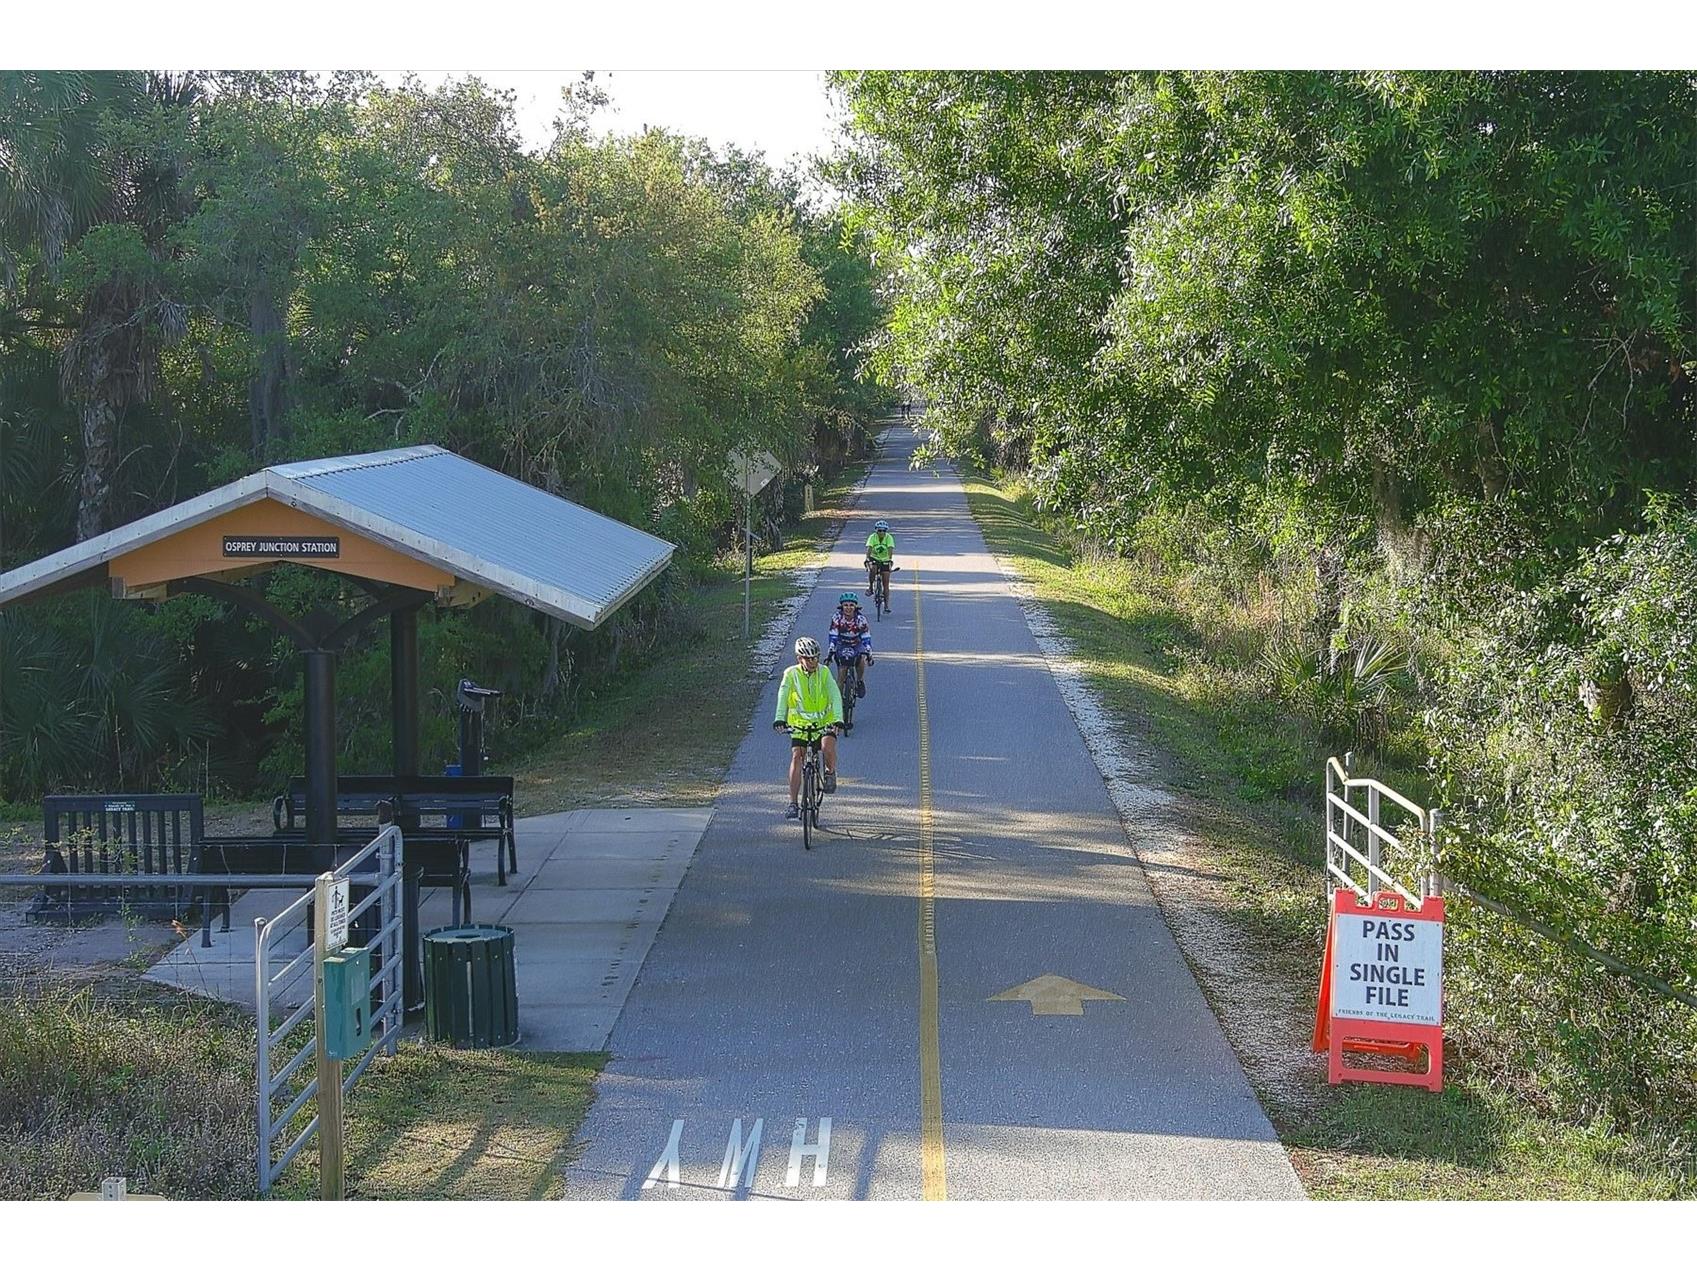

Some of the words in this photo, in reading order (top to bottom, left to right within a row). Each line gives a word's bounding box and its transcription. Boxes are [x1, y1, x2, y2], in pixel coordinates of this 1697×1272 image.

[225, 542, 257, 552] OSPREY
[259, 542, 300, 552] JUNCTION
[301, 542, 337, 552] STATION
[1363, 920, 1415, 941] PASS
[1377, 943, 1399, 962] IN
[1350, 963, 1425, 986] SINGLE
[1366, 986, 1409, 1007] FILE
[1390, 1012, 1414, 1020] LEGACY
[641, 1117, 832, 1189] HWY
